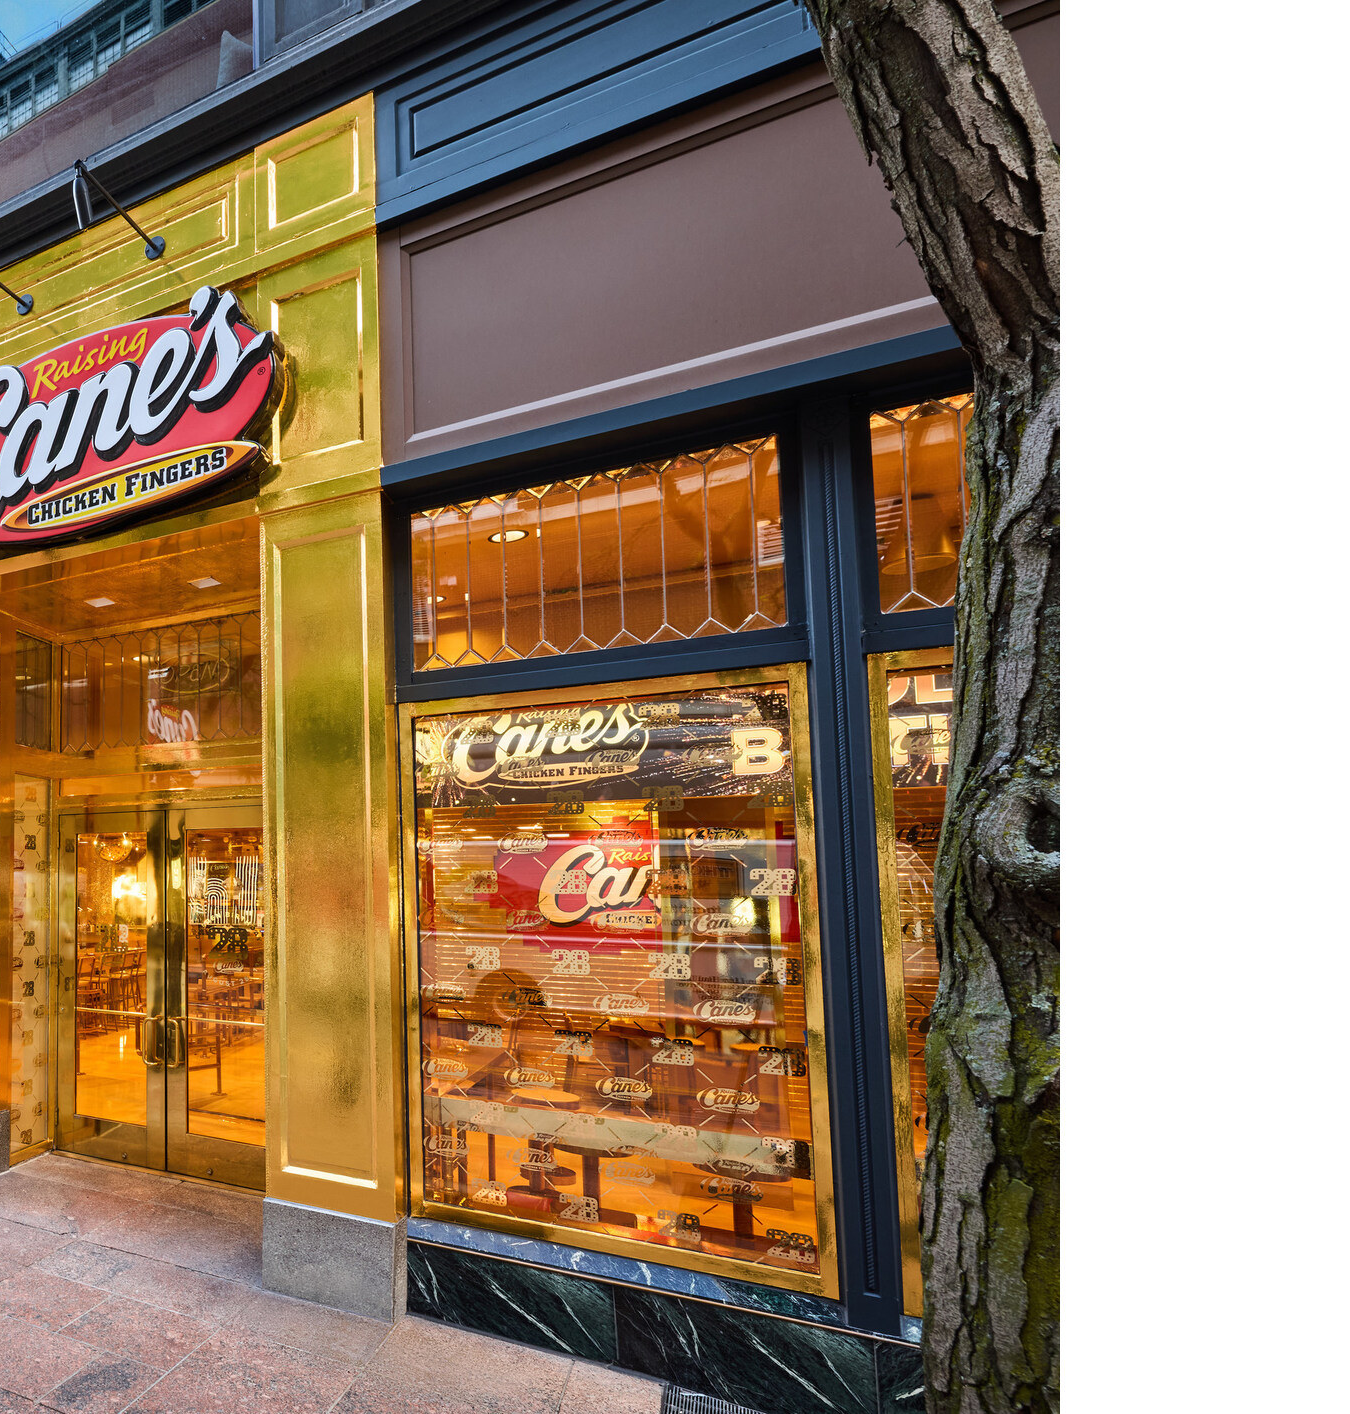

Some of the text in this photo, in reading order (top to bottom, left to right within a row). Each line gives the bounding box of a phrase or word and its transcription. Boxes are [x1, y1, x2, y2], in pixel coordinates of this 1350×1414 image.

[31, 328, 149, 398] Raising
[27, 448, 226, 526] CHICKEN FINGERS
[25, 834, 37, 850] 28
[550, 869, 588, 895] 28
[749, 868, 797, 896] 28
[23, 930, 36, 947] 28
[207, 927, 249, 960] 28
[465, 945, 501, 971] 28
[551, 948, 591, 975] 28
[648, 952, 692, 980] 28
[754, 956, 801, 987] 28
[22, 980, 35, 998] 28
[467, 1021, 503, 1048] 28
[554, 1029, 593, 1057] 28
[651, 1036, 695, 1067] 28
[758, 1045, 807, 1077] 28
[598, 1076, 652, 1098] Cane's
[698, 1088, 760, 1111] Cane's
[471, 1177, 508, 1207] 28
[559, 1193, 600, 1224] 28
[657, 1209, 701, 1243] 28
[766, 1228, 815, 1264] 28
